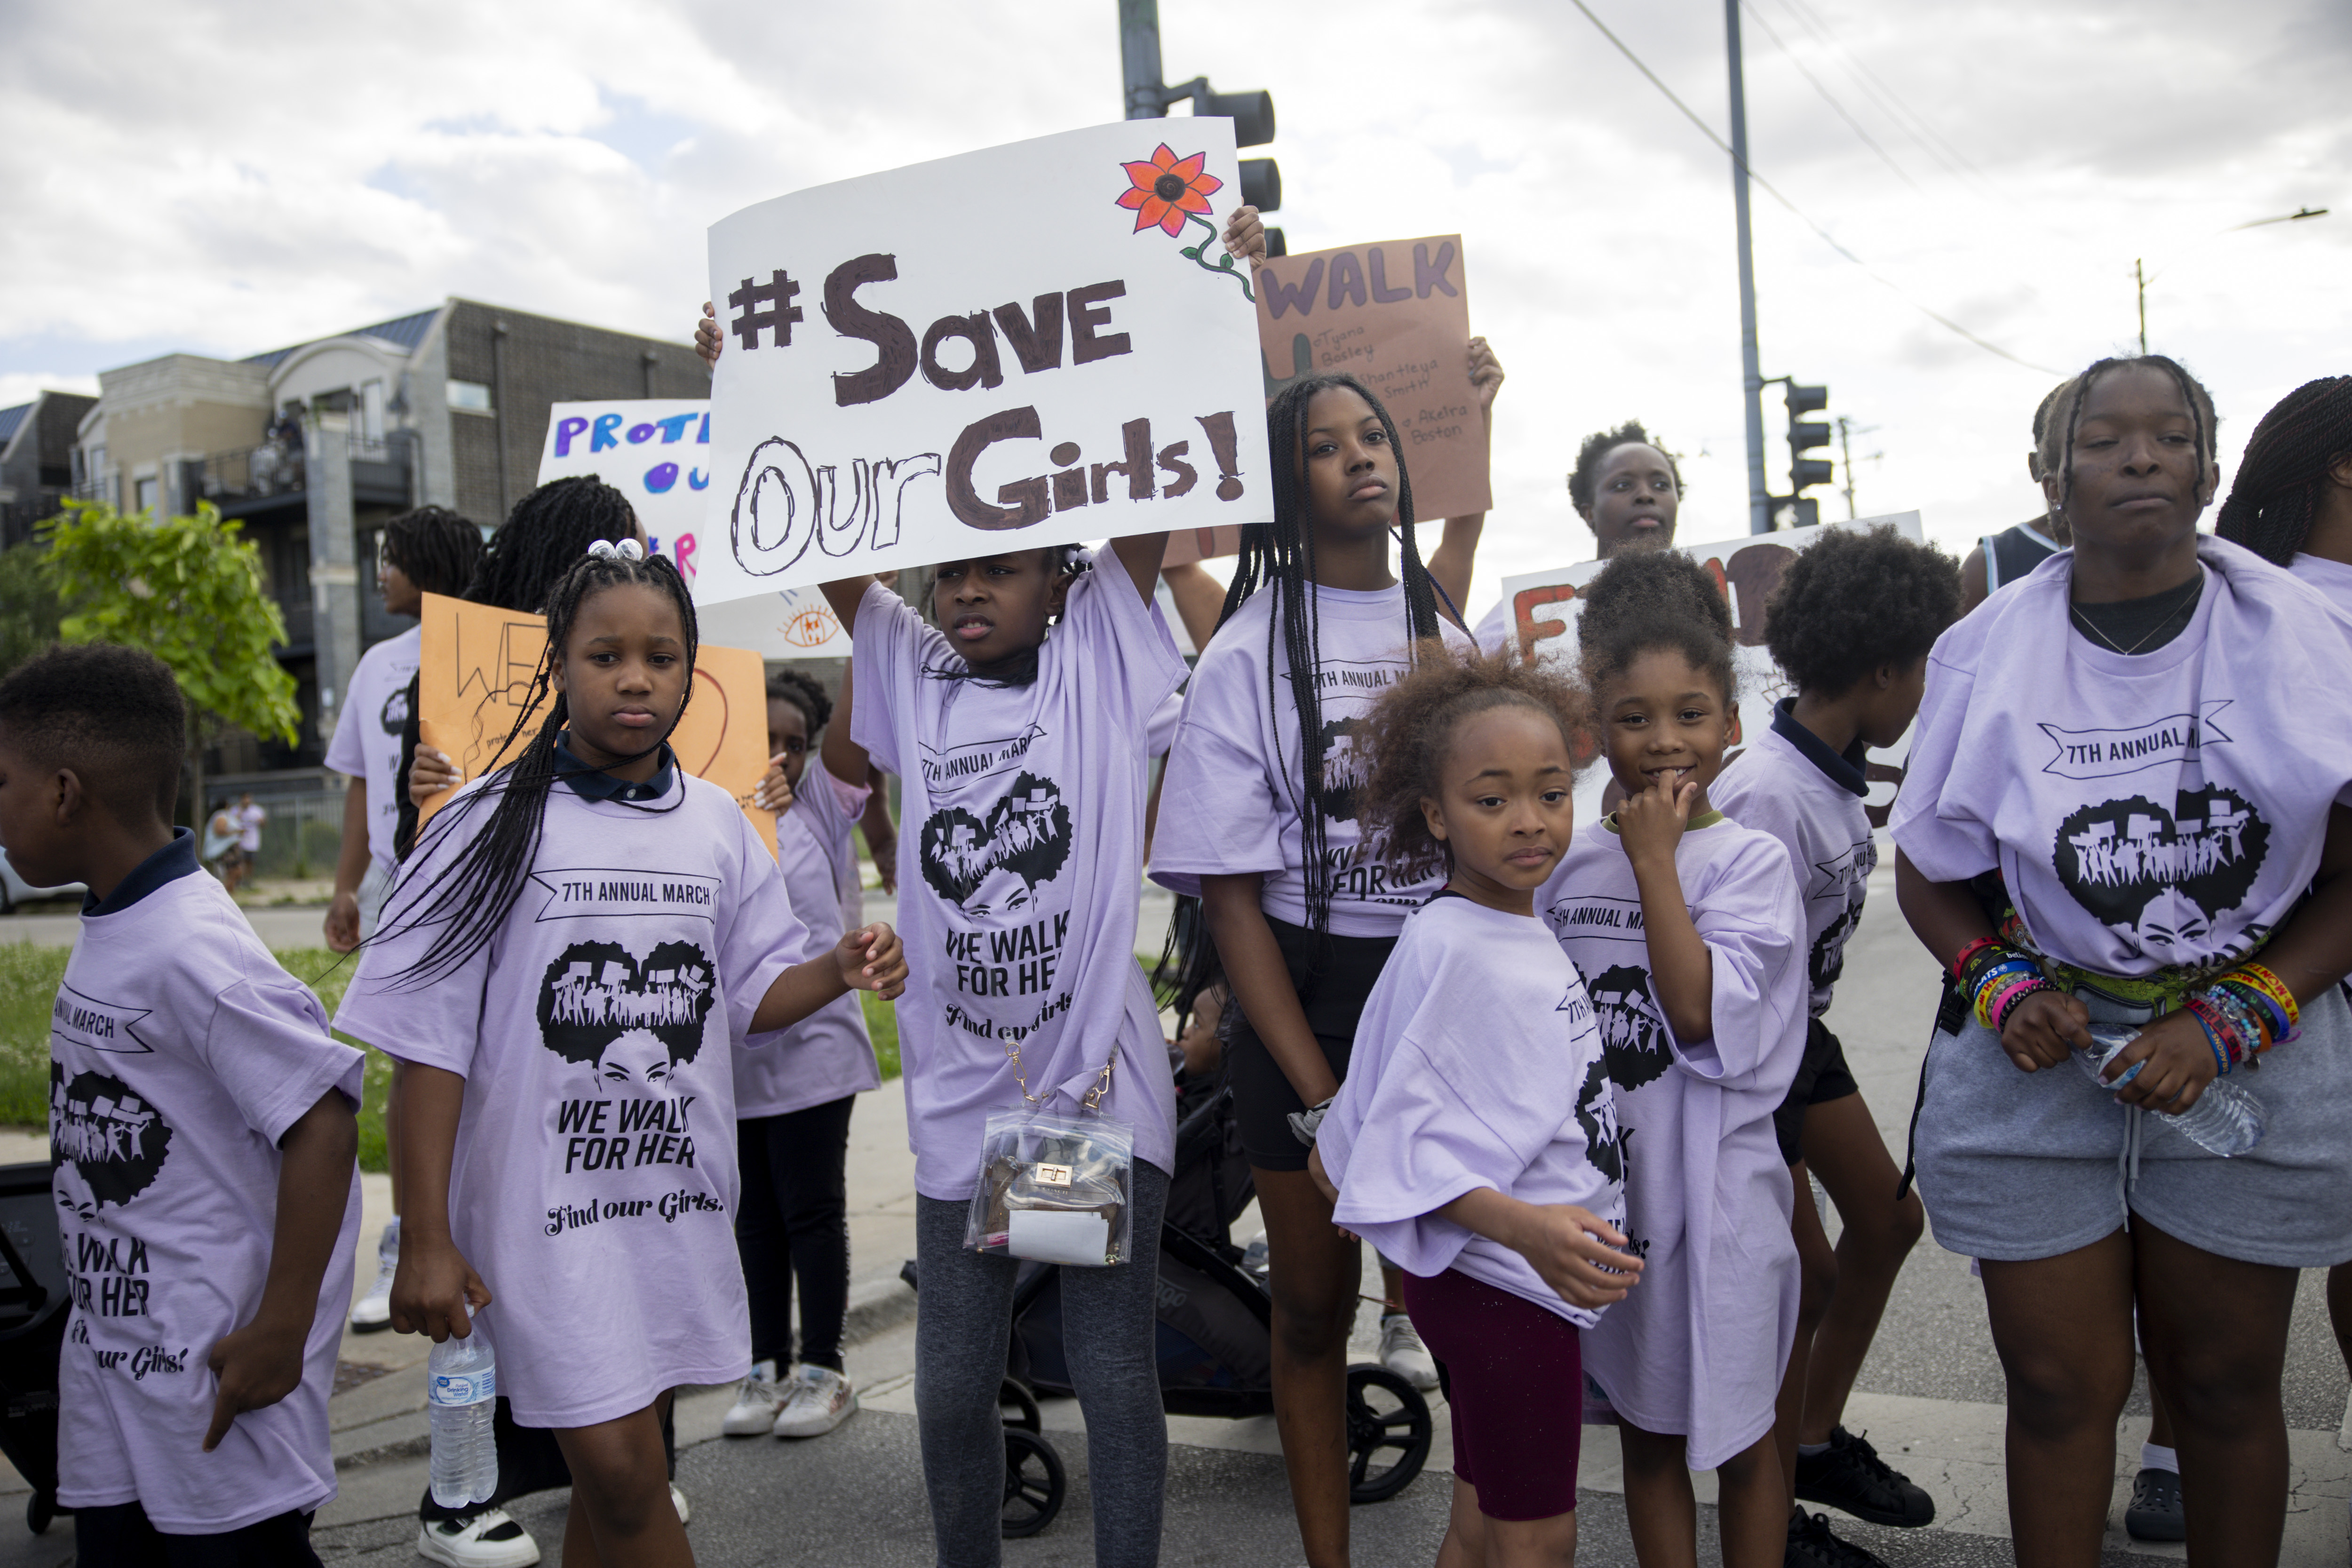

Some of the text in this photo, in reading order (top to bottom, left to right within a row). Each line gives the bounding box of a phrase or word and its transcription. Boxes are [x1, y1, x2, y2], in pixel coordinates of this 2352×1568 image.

[1261, 241, 1458, 320] WALK
[1318, 326, 1364, 350] Tyana
[1321, 344, 1374, 366] Bosley
[1411, 424, 1462, 445] Boston
[946, 405, 1244, 531] Girls!
[1342, 669, 1391, 688] ANNUAL
[521, 727, 539, 738] her
[2066, 743, 2102, 764] 7TH
[2109, 727, 2185, 761] ANNUAL
[562, 882, 711, 906] 7TH ANNUAL MARCH
[1569, 907, 1621, 928] ANNUAL
[946, 909, 1070, 965] WE WALK
[956, 964, 1010, 997] FOR
[72, 1006, 114, 1039] MARCH
[944, 1003, 993, 1039] Find
[2211, 1032, 2229, 1073] DRAGONS
[557, 1096, 697, 1134] WE WALK
[564, 1134, 696, 1174] FOR HER
[1042, 1186, 1069, 1195] COACH
[544, 1198, 600, 1237] Find
[603, 1200, 653, 1219] our
[101, 1276, 150, 1318] HER
